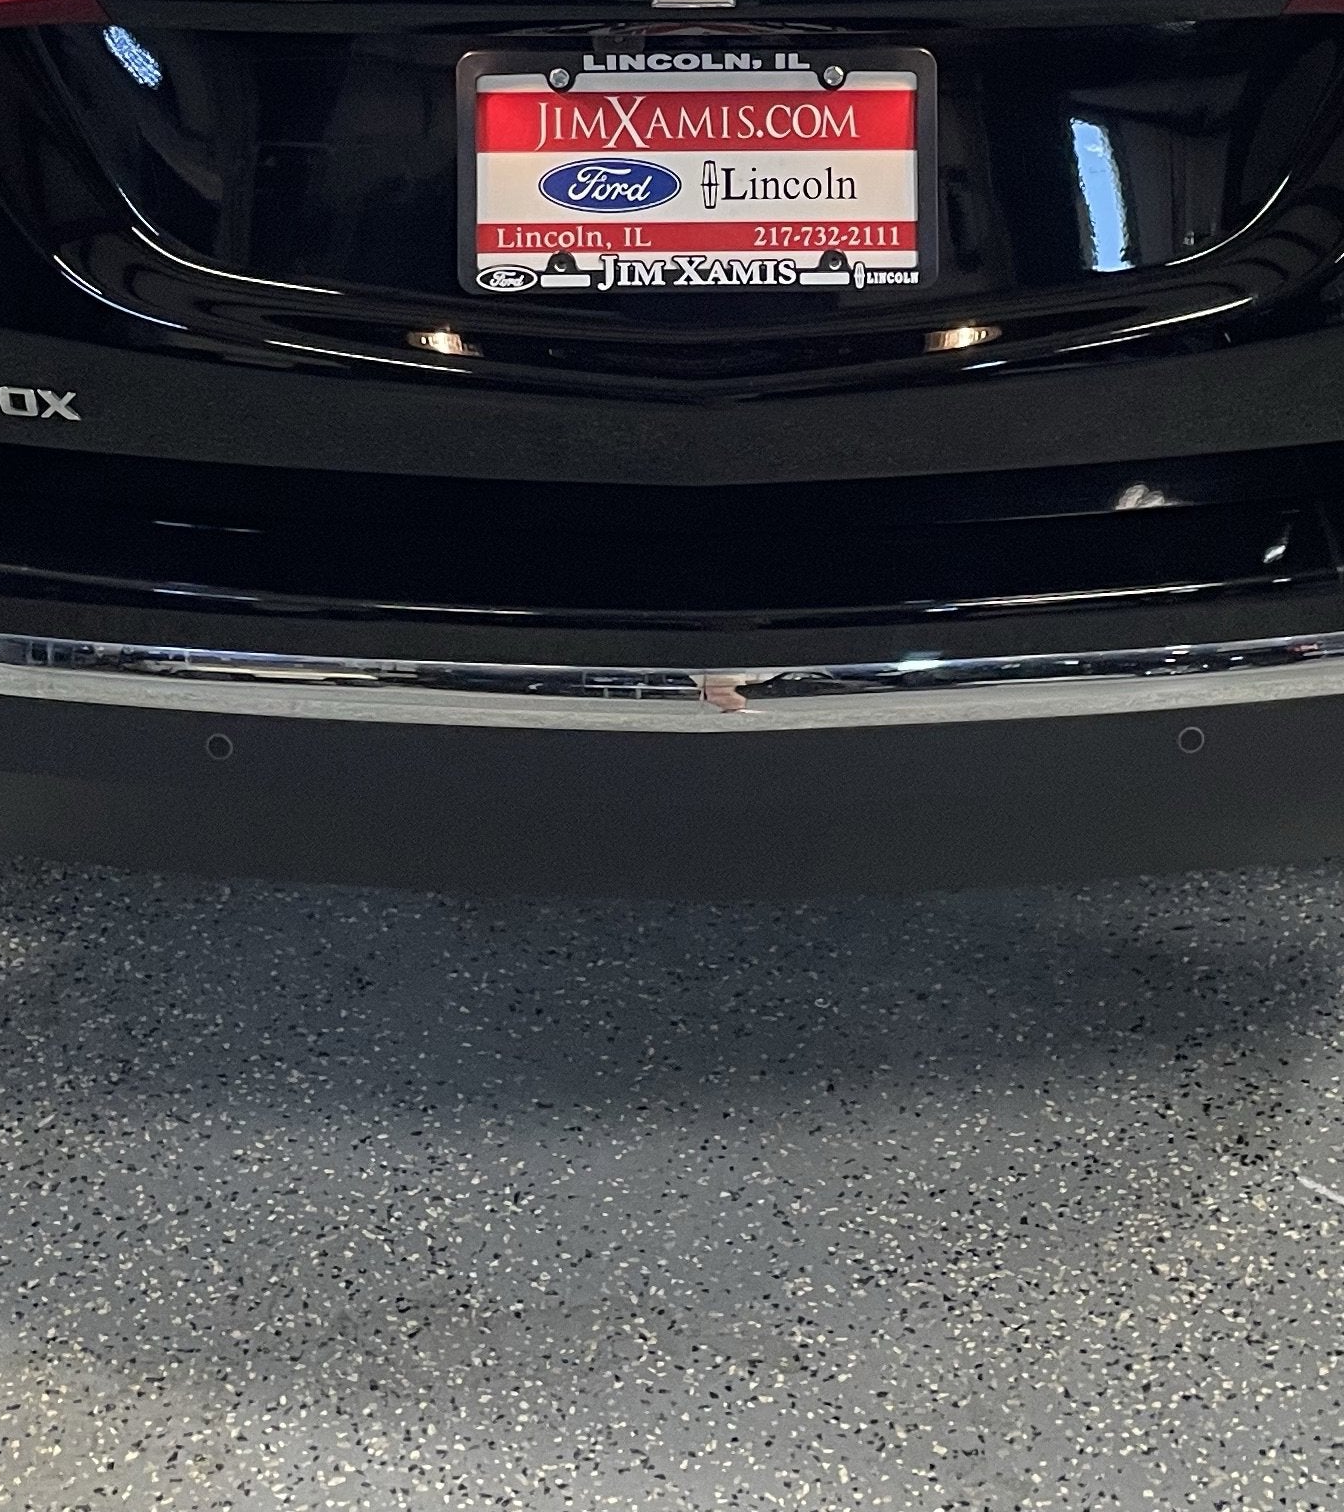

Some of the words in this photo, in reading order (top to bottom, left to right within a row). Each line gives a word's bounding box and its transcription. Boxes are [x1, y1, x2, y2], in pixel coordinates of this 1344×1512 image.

[583, 53, 762, 71] LINCOLN,
[774, 52, 810, 70] IL
[568, 166, 652, 202] Ford
[720, 166, 858, 201] Lincoln
[496, 225, 613, 250] Lincoln,
[623, 227, 652, 248] IL
[754, 226, 900, 248] 217-732-2111
[597, 254, 666, 291] JIM
[673, 255, 797, 287] XAMIS
[866, 271, 919, 285] LINCOLN
